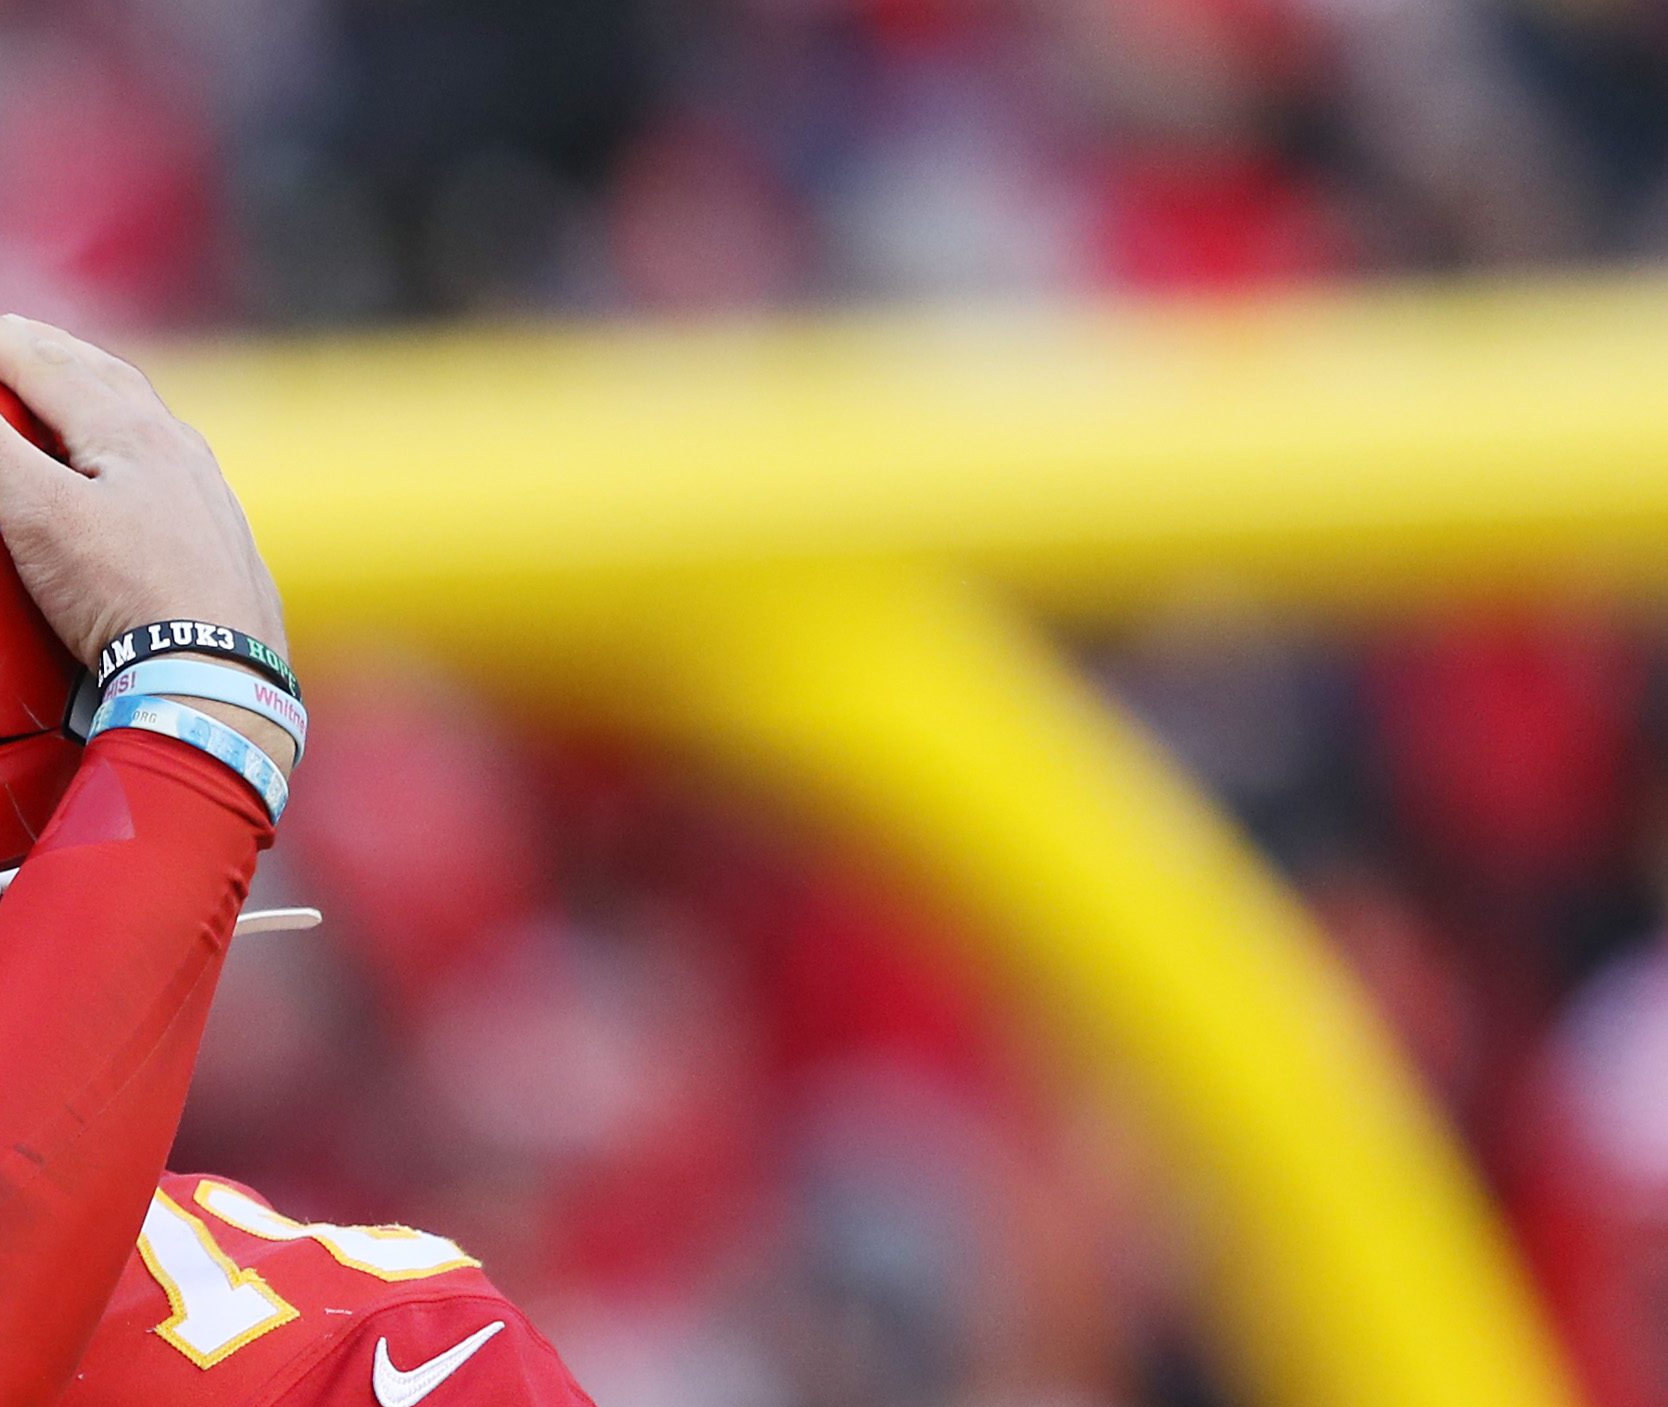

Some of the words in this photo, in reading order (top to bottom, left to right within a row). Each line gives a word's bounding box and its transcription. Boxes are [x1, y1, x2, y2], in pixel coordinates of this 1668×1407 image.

[98, 633, 136, 688] AM
[148, 621, 235, 651] LUK3
[247, 638, 297, 696] HOPE
[103, 671, 136, 702] HIS!
[254, 683, 306, 734] Whitne
